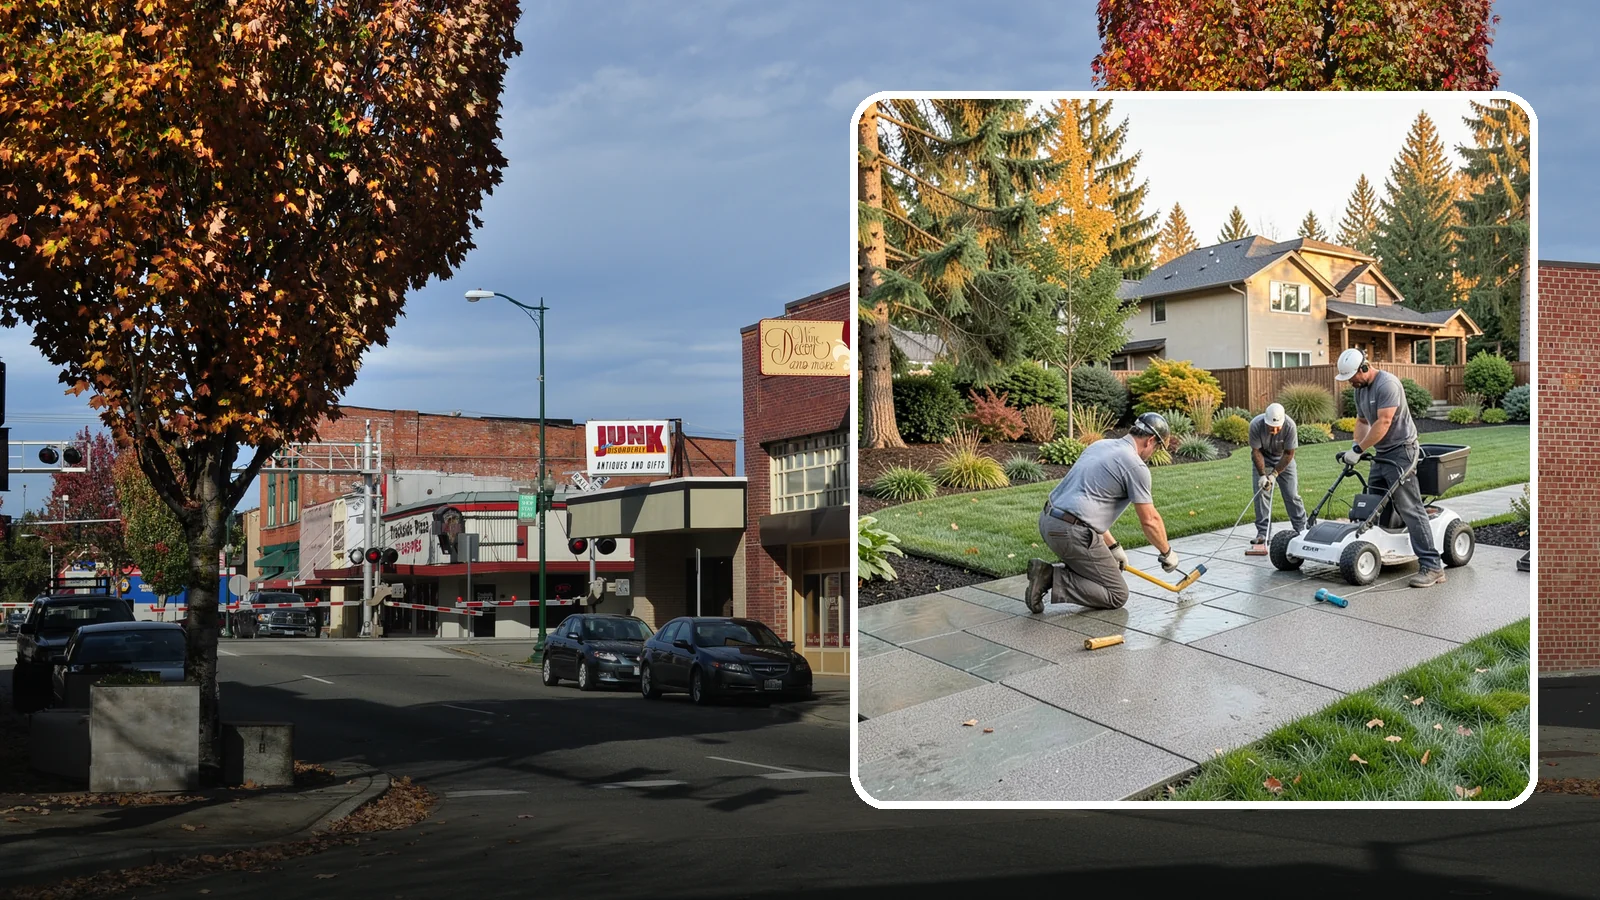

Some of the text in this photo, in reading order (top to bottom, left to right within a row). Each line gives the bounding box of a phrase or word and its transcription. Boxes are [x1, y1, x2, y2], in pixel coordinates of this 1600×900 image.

[596, 426, 664, 457] JUNK
[597, 461, 665, 470] ANTIQUES AND GIFTS
[390, 519, 429, 540] Trackside Pizza
